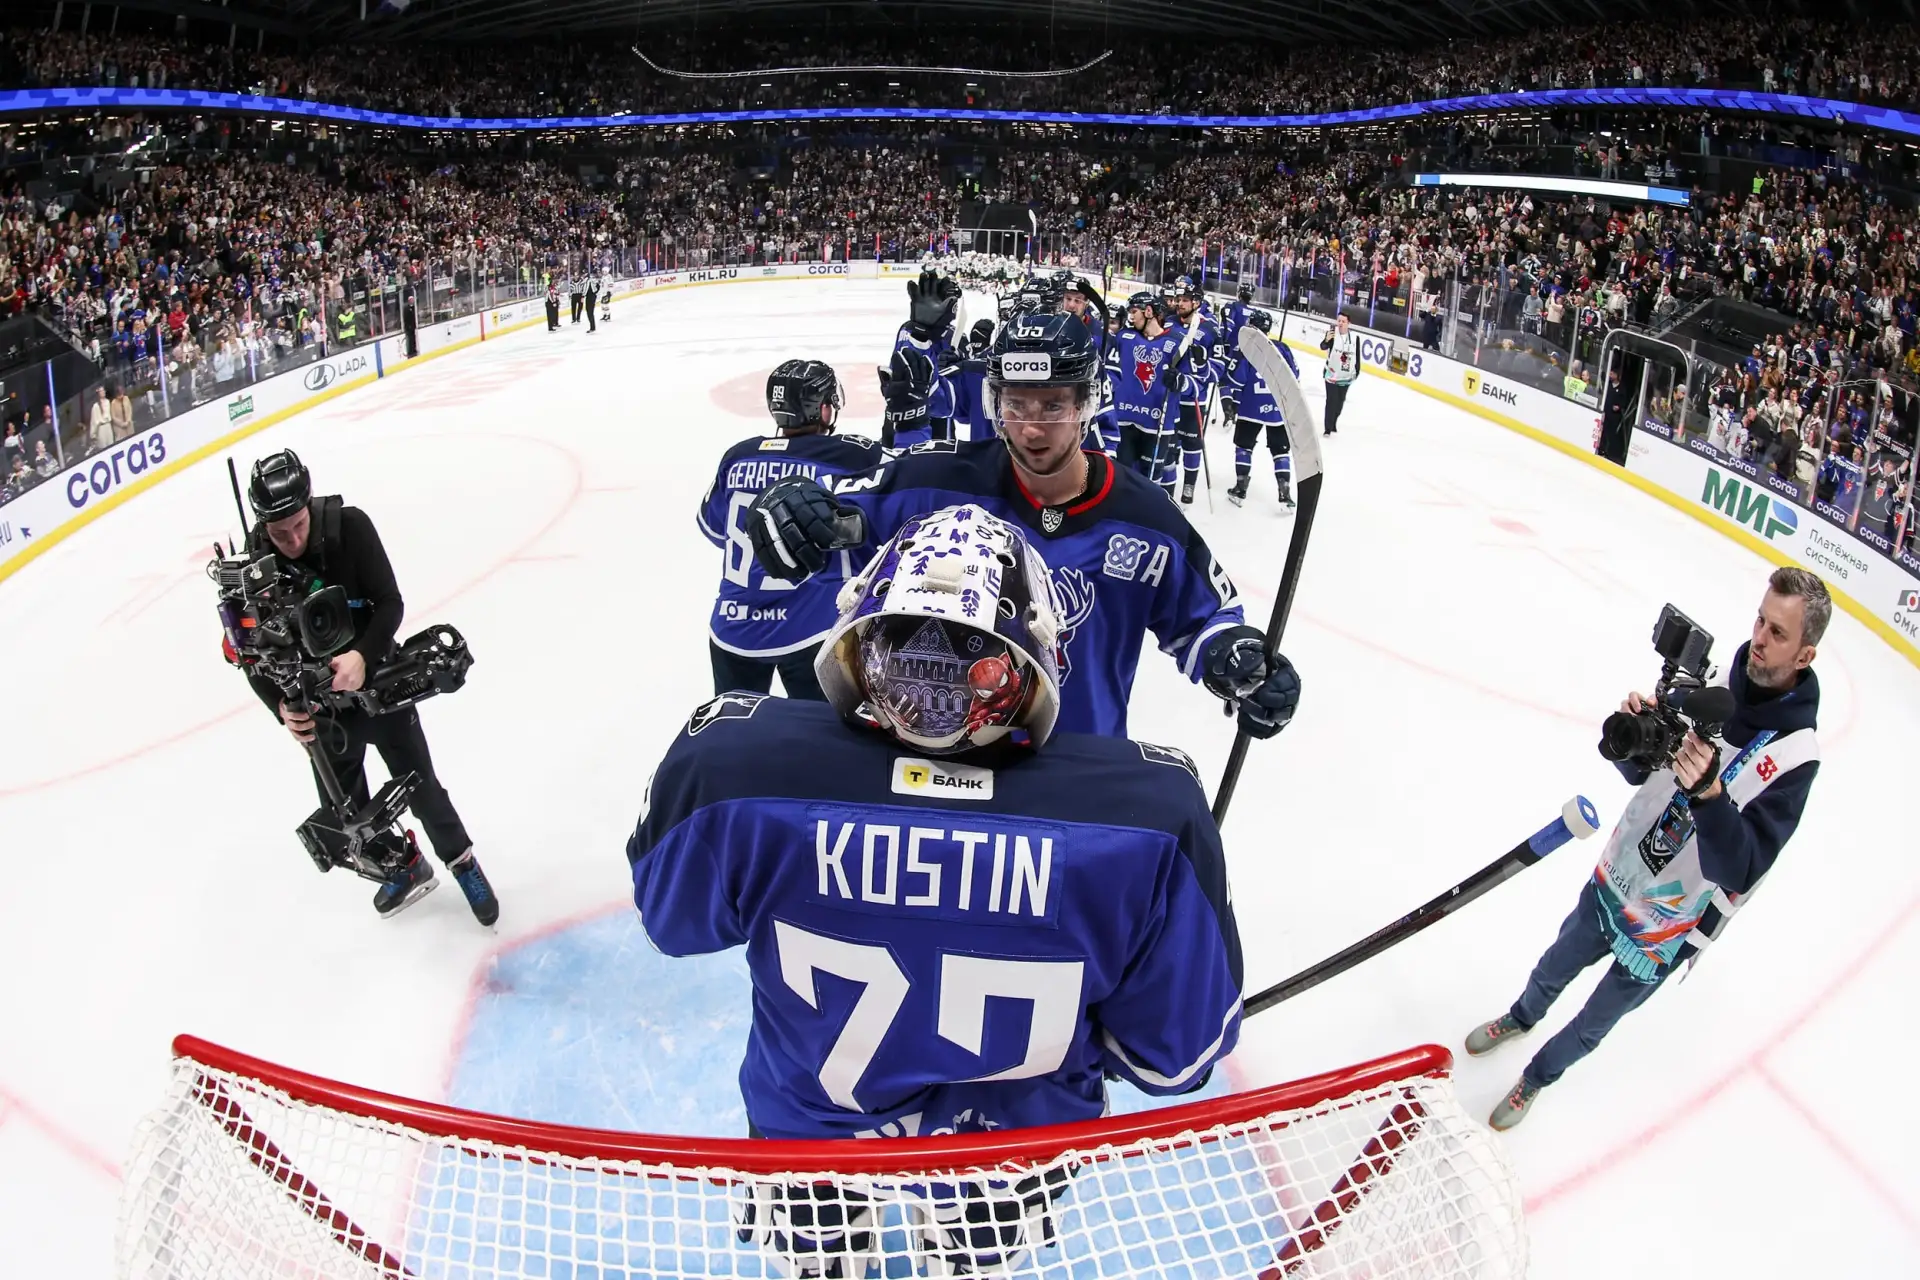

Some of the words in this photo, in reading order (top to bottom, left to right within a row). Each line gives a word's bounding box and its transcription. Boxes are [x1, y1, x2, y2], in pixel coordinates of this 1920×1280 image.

[689, 269, 738, 282] KHL.RU
[338, 356, 368, 377] LADA
[772, 385, 785, 399] 89
[1481, 382, 1518, 406] БАНК
[1118, 402, 1150, 415] SPAR
[727, 461, 816, 489] GERASKIN
[1702, 467, 1798, 540] МИР
[1805, 546, 1848, 580] система
[1809, 528, 1868, 575] Платёжная
[1140, 544, 1170, 588] A
[932, 774, 984, 790] БАНК
[815, 820, 1054, 917] KOSTIN
[773, 919, 1085, 1114] 77
